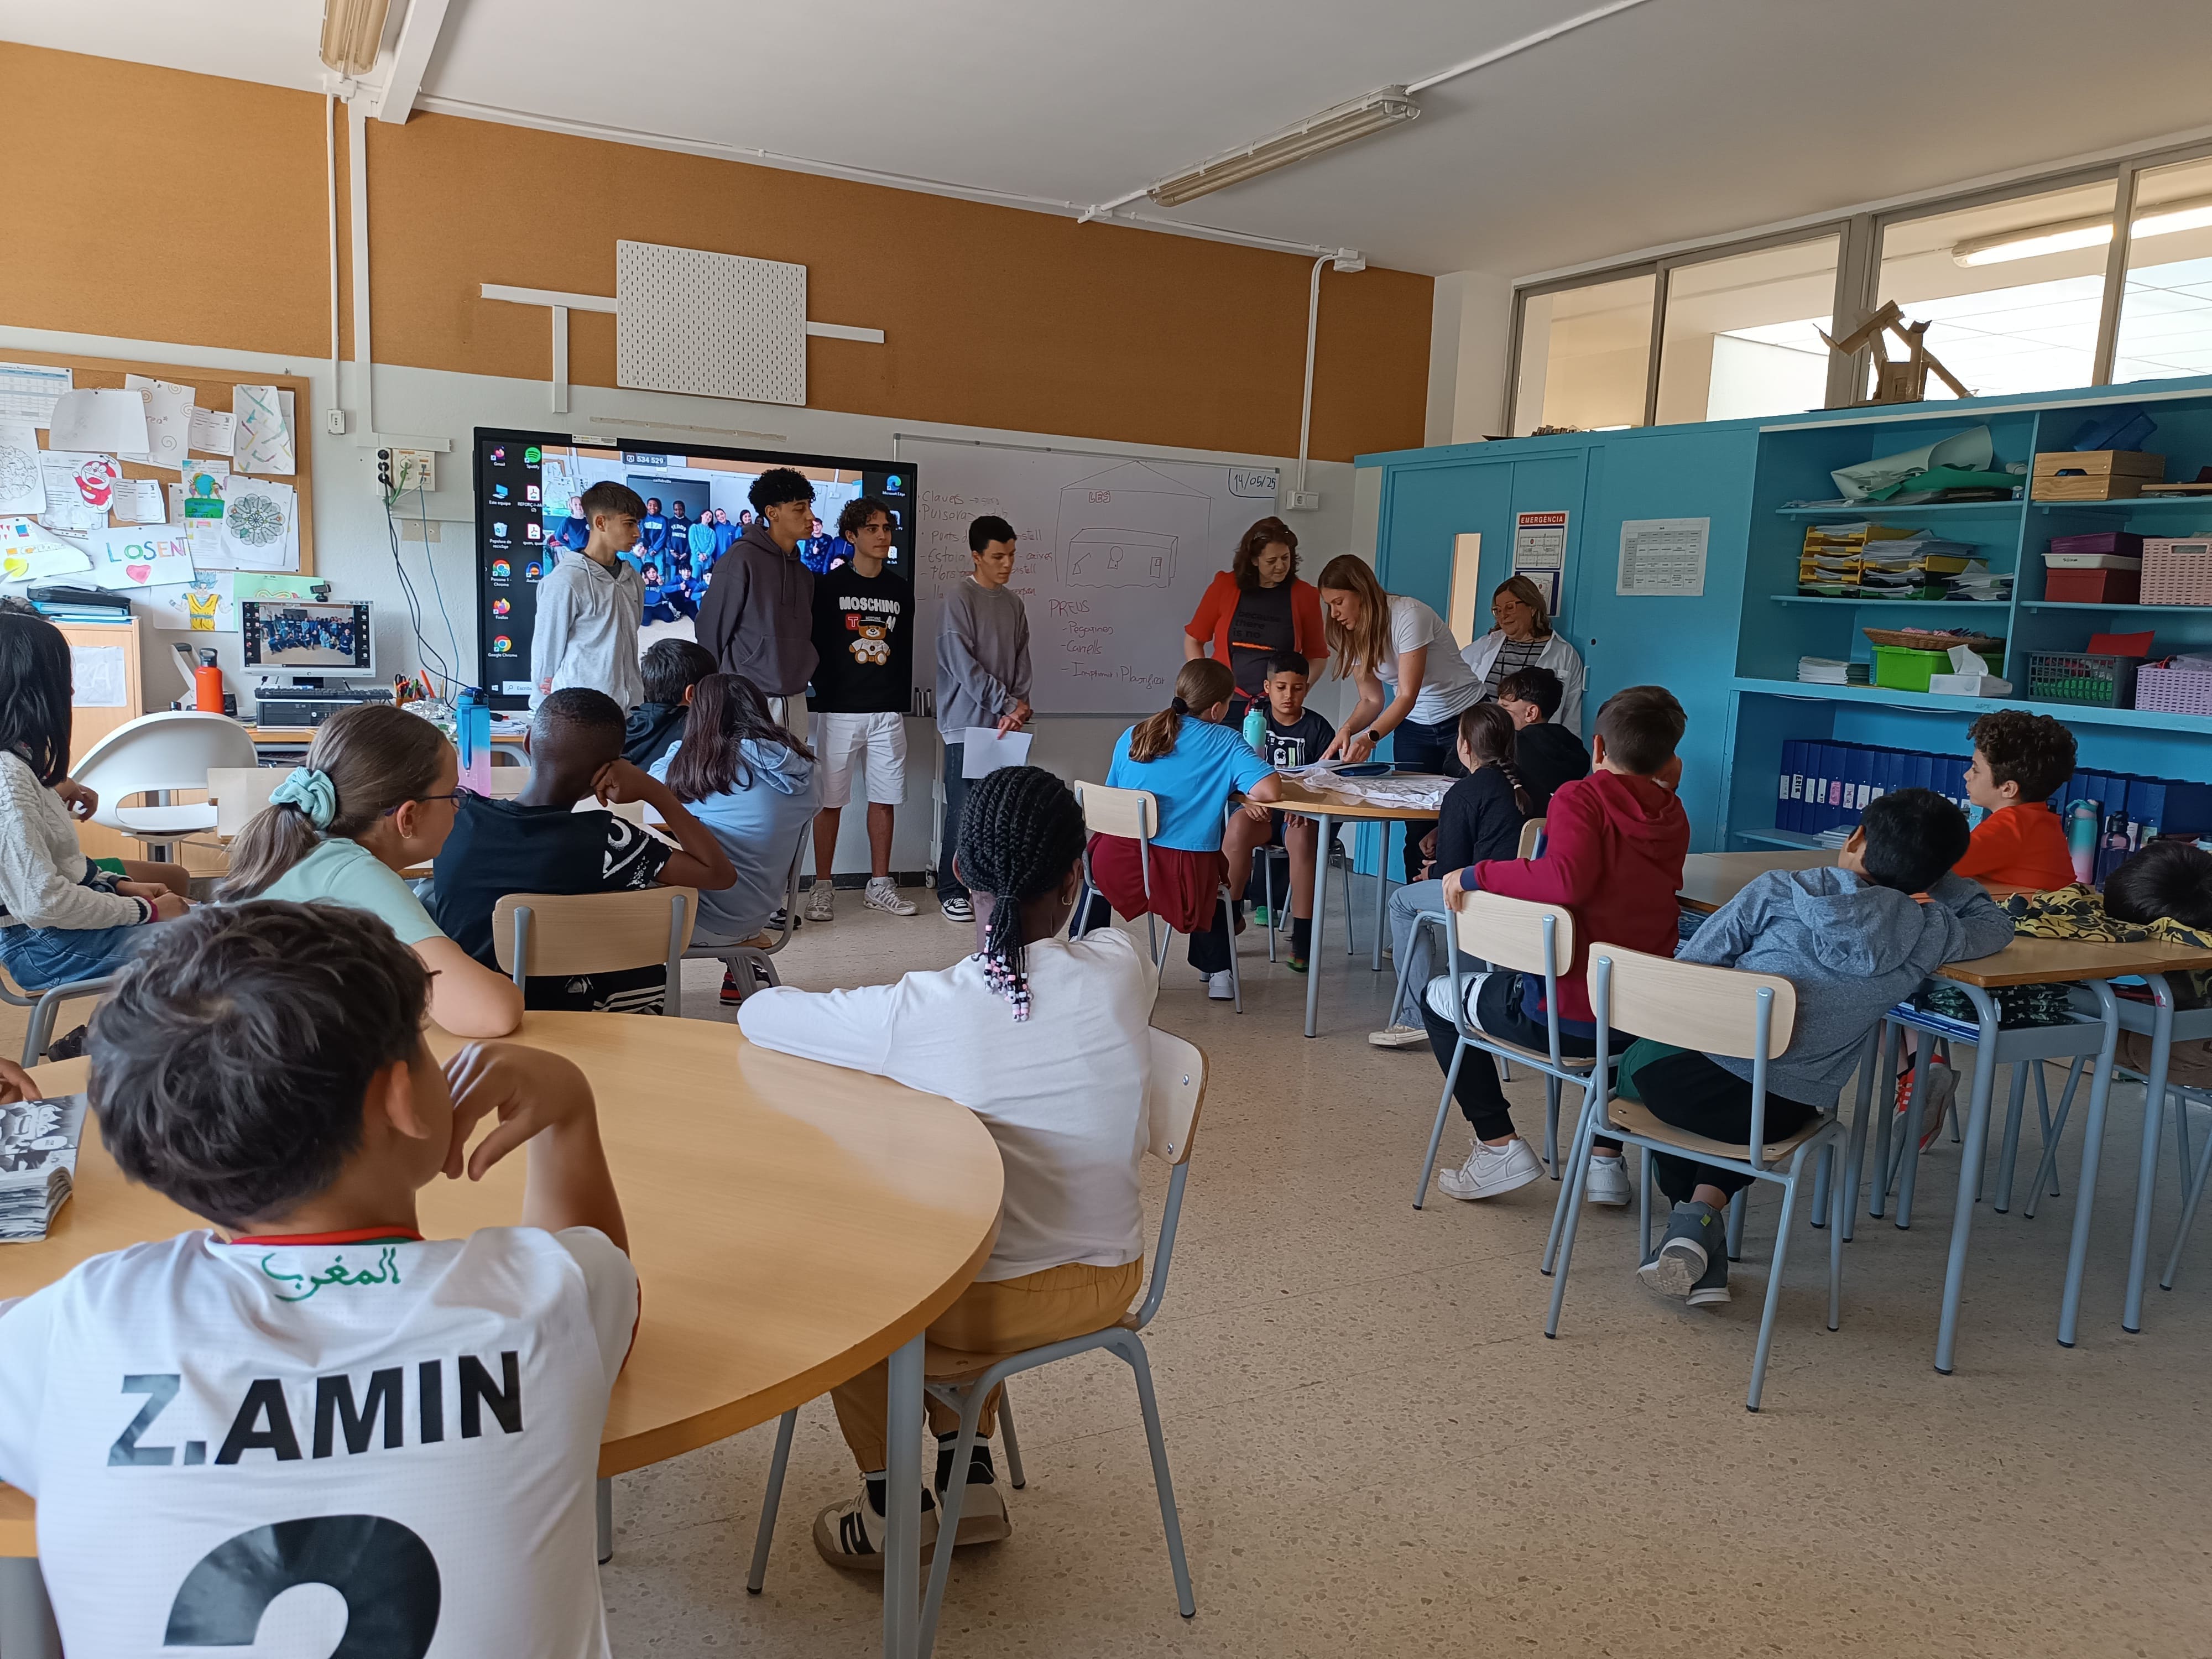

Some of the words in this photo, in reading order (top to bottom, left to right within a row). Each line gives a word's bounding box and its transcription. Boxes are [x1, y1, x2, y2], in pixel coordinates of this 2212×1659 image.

[1234, 472, 1276, 492] 14/05/25
[1521, 515, 1563, 524] EMERGÈNCIA
[839, 596, 900, 615] MOSCHINO
[1048, 599, 1090, 618] PREUS
[1235, 619, 1265, 629] there
[1239, 609, 1281, 623] because
[1233, 628, 1242, 637] is
[262, 1246, 401, 1302] المغرب
[107, 1350, 524, 1467] Z.AMIN
